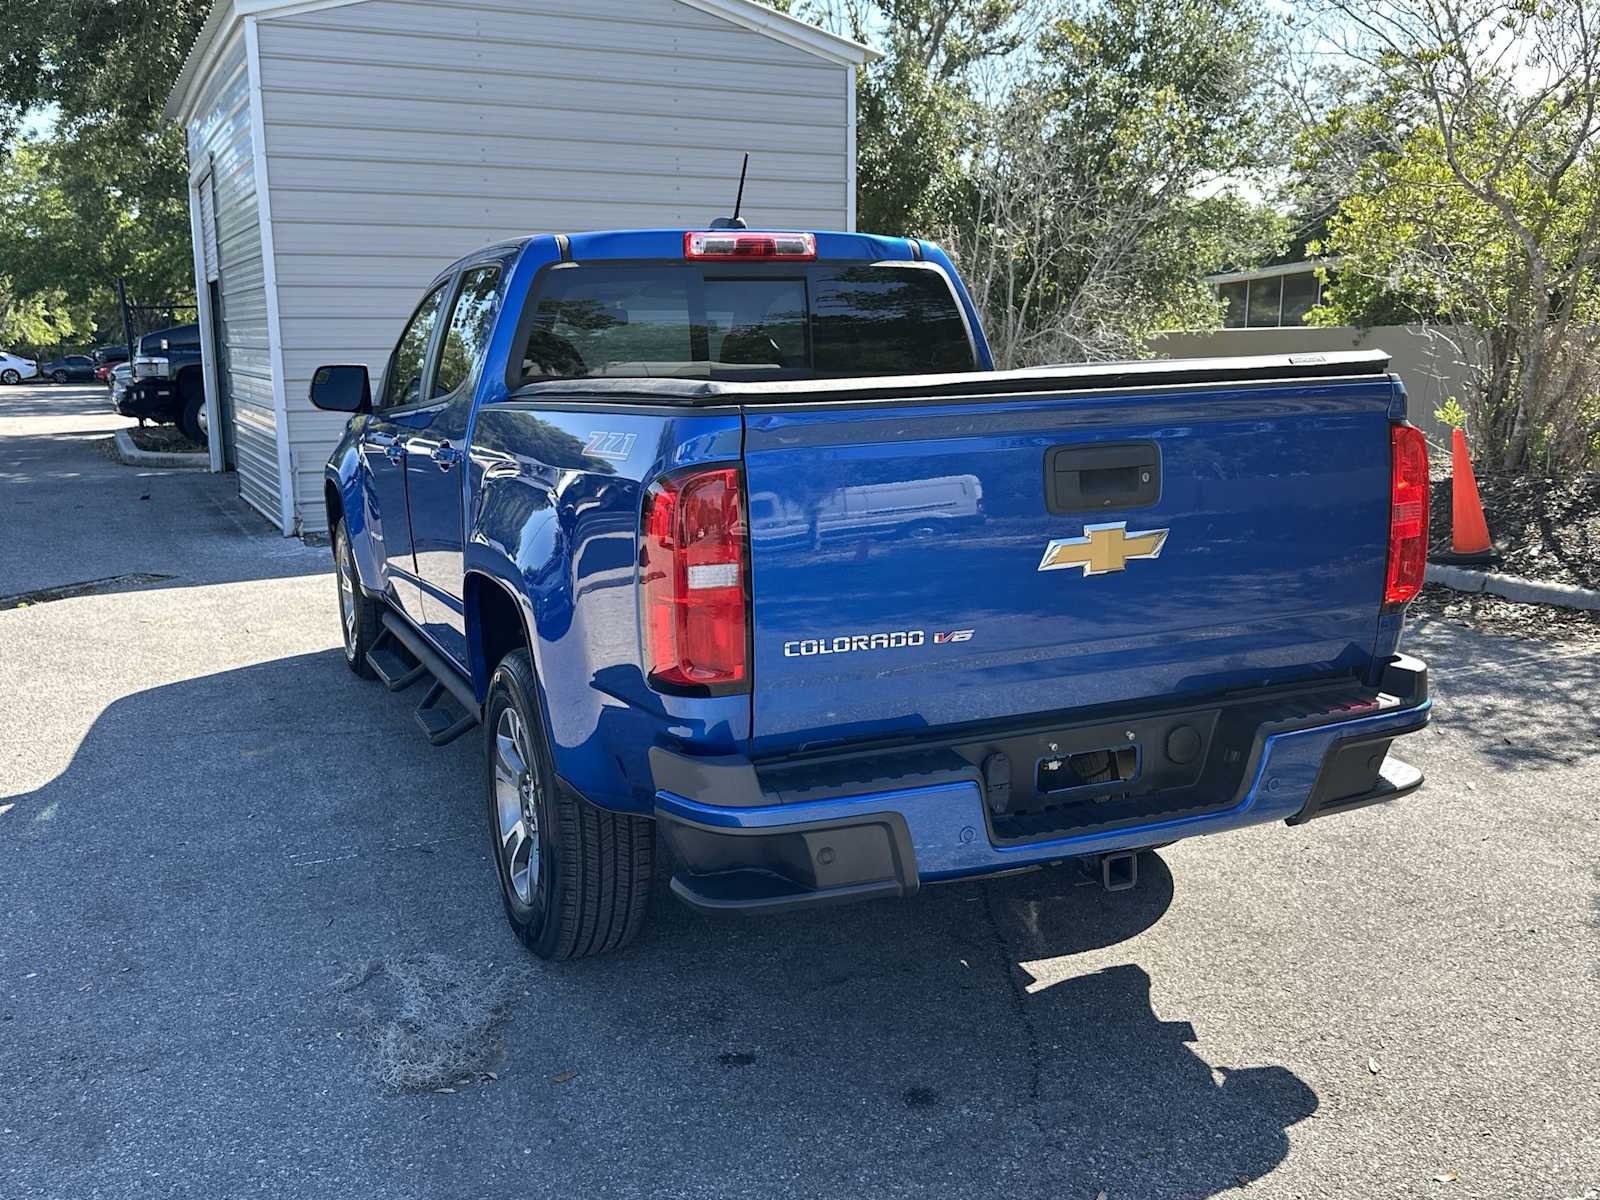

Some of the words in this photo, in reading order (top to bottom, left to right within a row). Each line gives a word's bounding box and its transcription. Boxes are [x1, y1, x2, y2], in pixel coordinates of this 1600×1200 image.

[581, 431, 637, 460] Z71
[784, 630, 924, 657] COLORADO
[933, 629, 975, 643] V6
